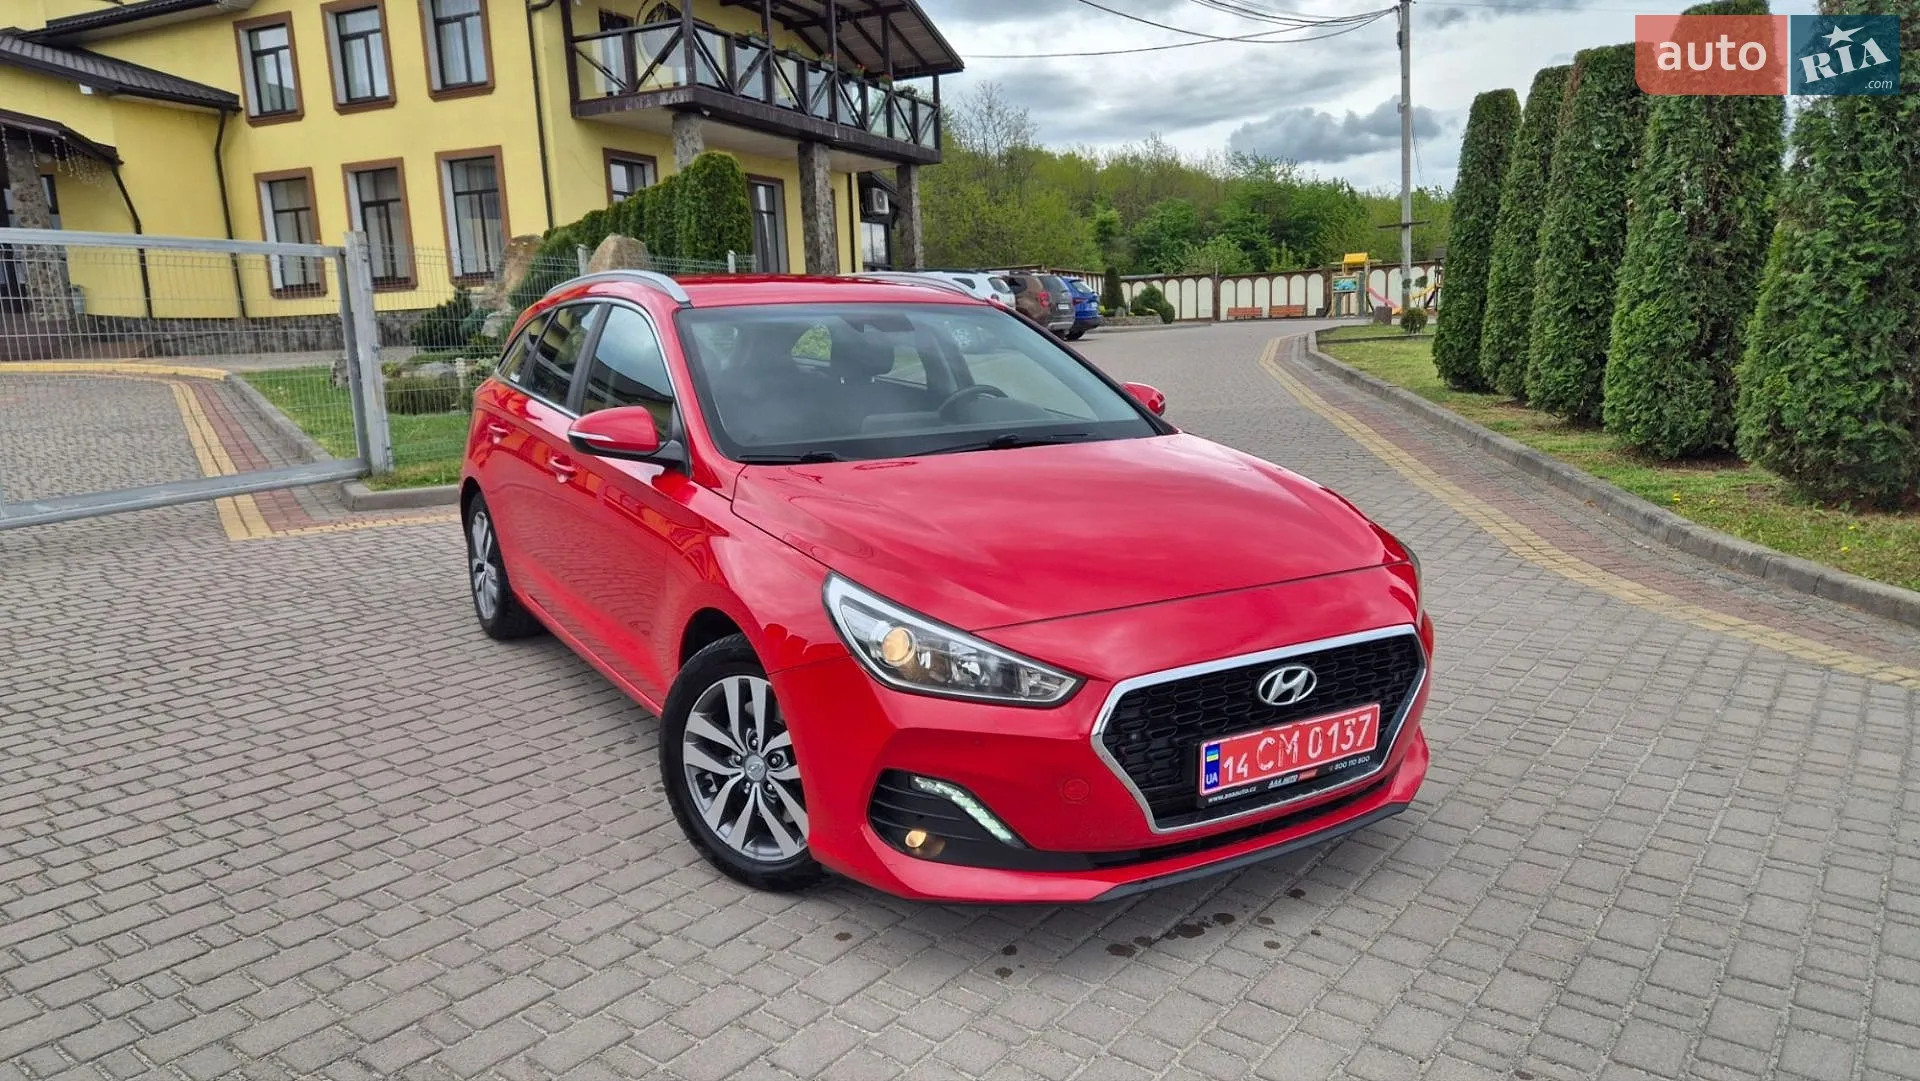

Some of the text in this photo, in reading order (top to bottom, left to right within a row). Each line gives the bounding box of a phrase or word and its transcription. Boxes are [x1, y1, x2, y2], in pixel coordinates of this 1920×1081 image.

[1223, 713, 1372, 782] 14 CM 0137
[1206, 772, 1218, 785] UA
